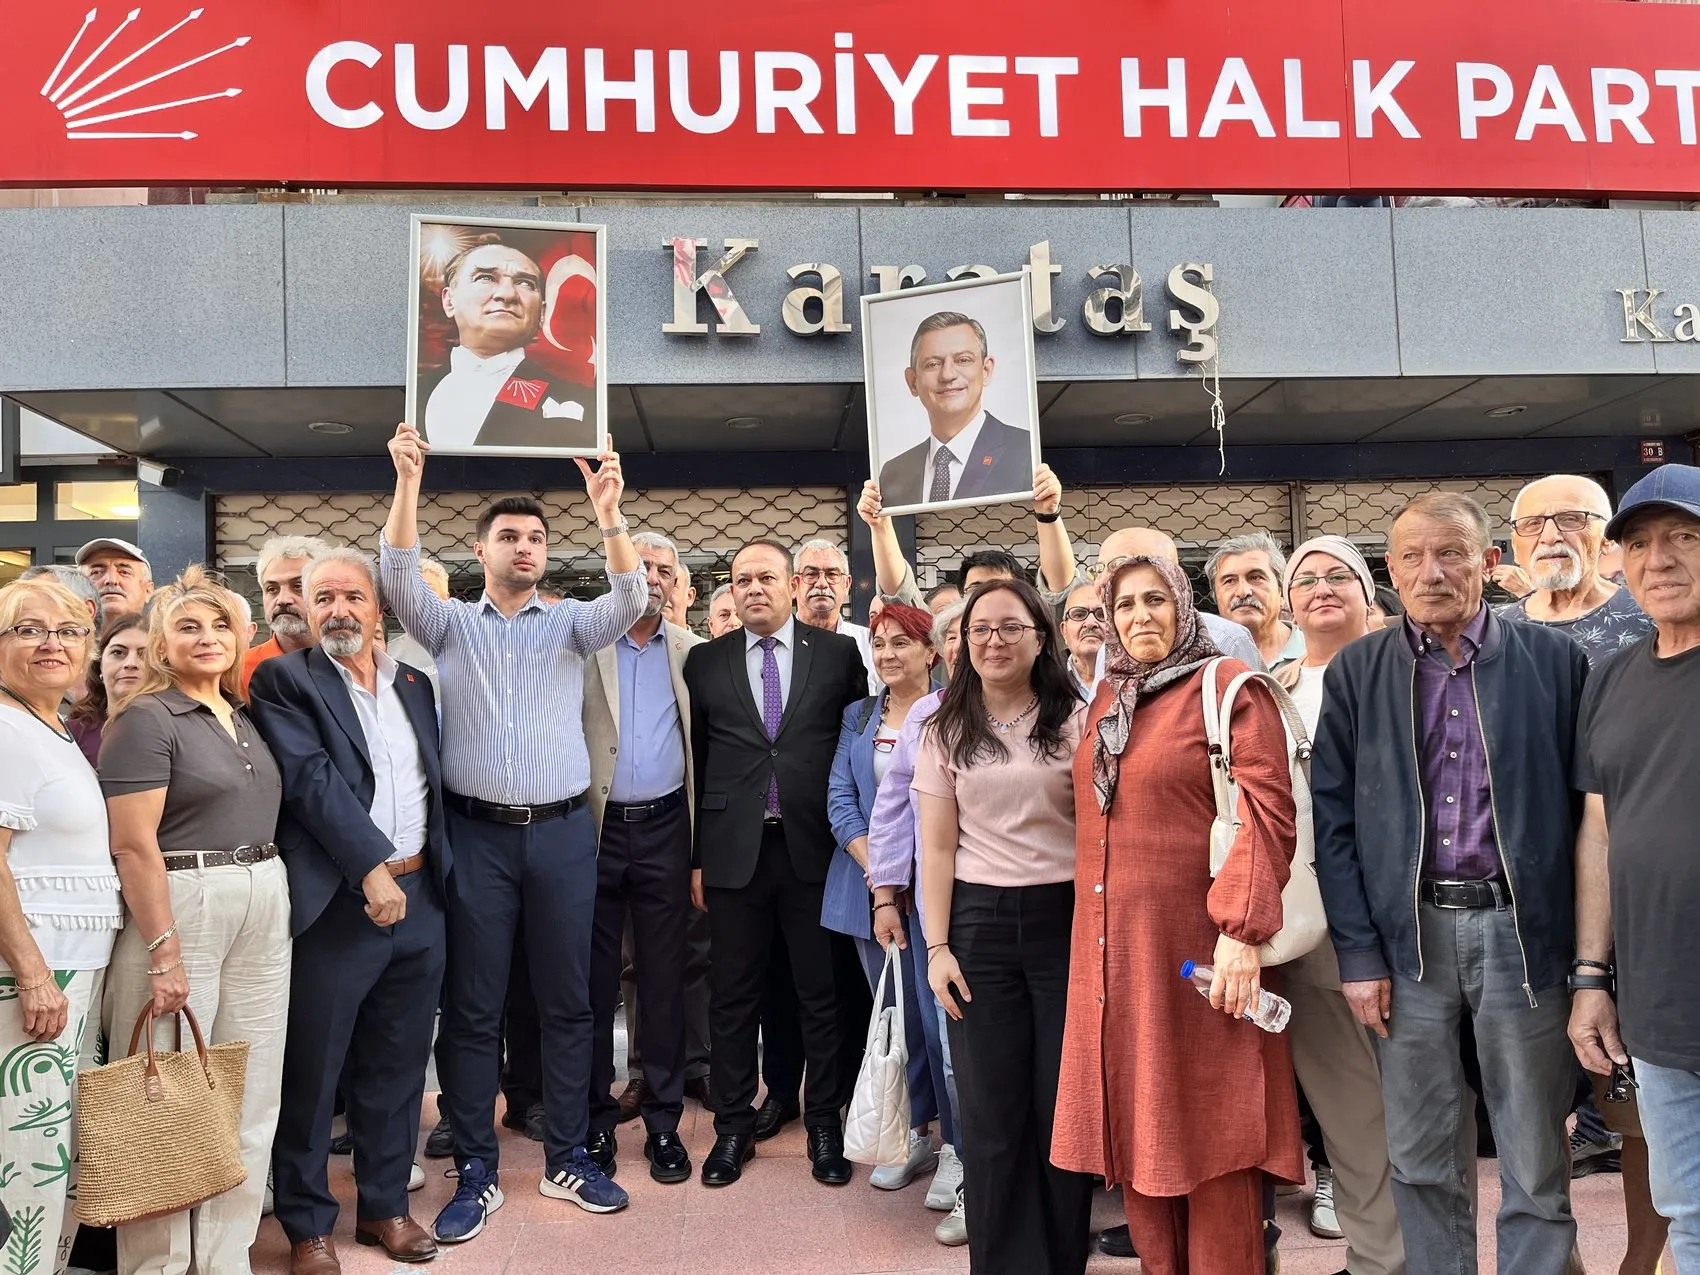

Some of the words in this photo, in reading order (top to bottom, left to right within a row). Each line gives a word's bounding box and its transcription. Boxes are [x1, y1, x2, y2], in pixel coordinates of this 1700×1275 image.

[305, 32, 1079, 138] CUMHURİYET
[1120, 57, 1422, 140] HALK
[1456, 61, 1700, 145] PART
[1657, 447, 1664, 456] B
